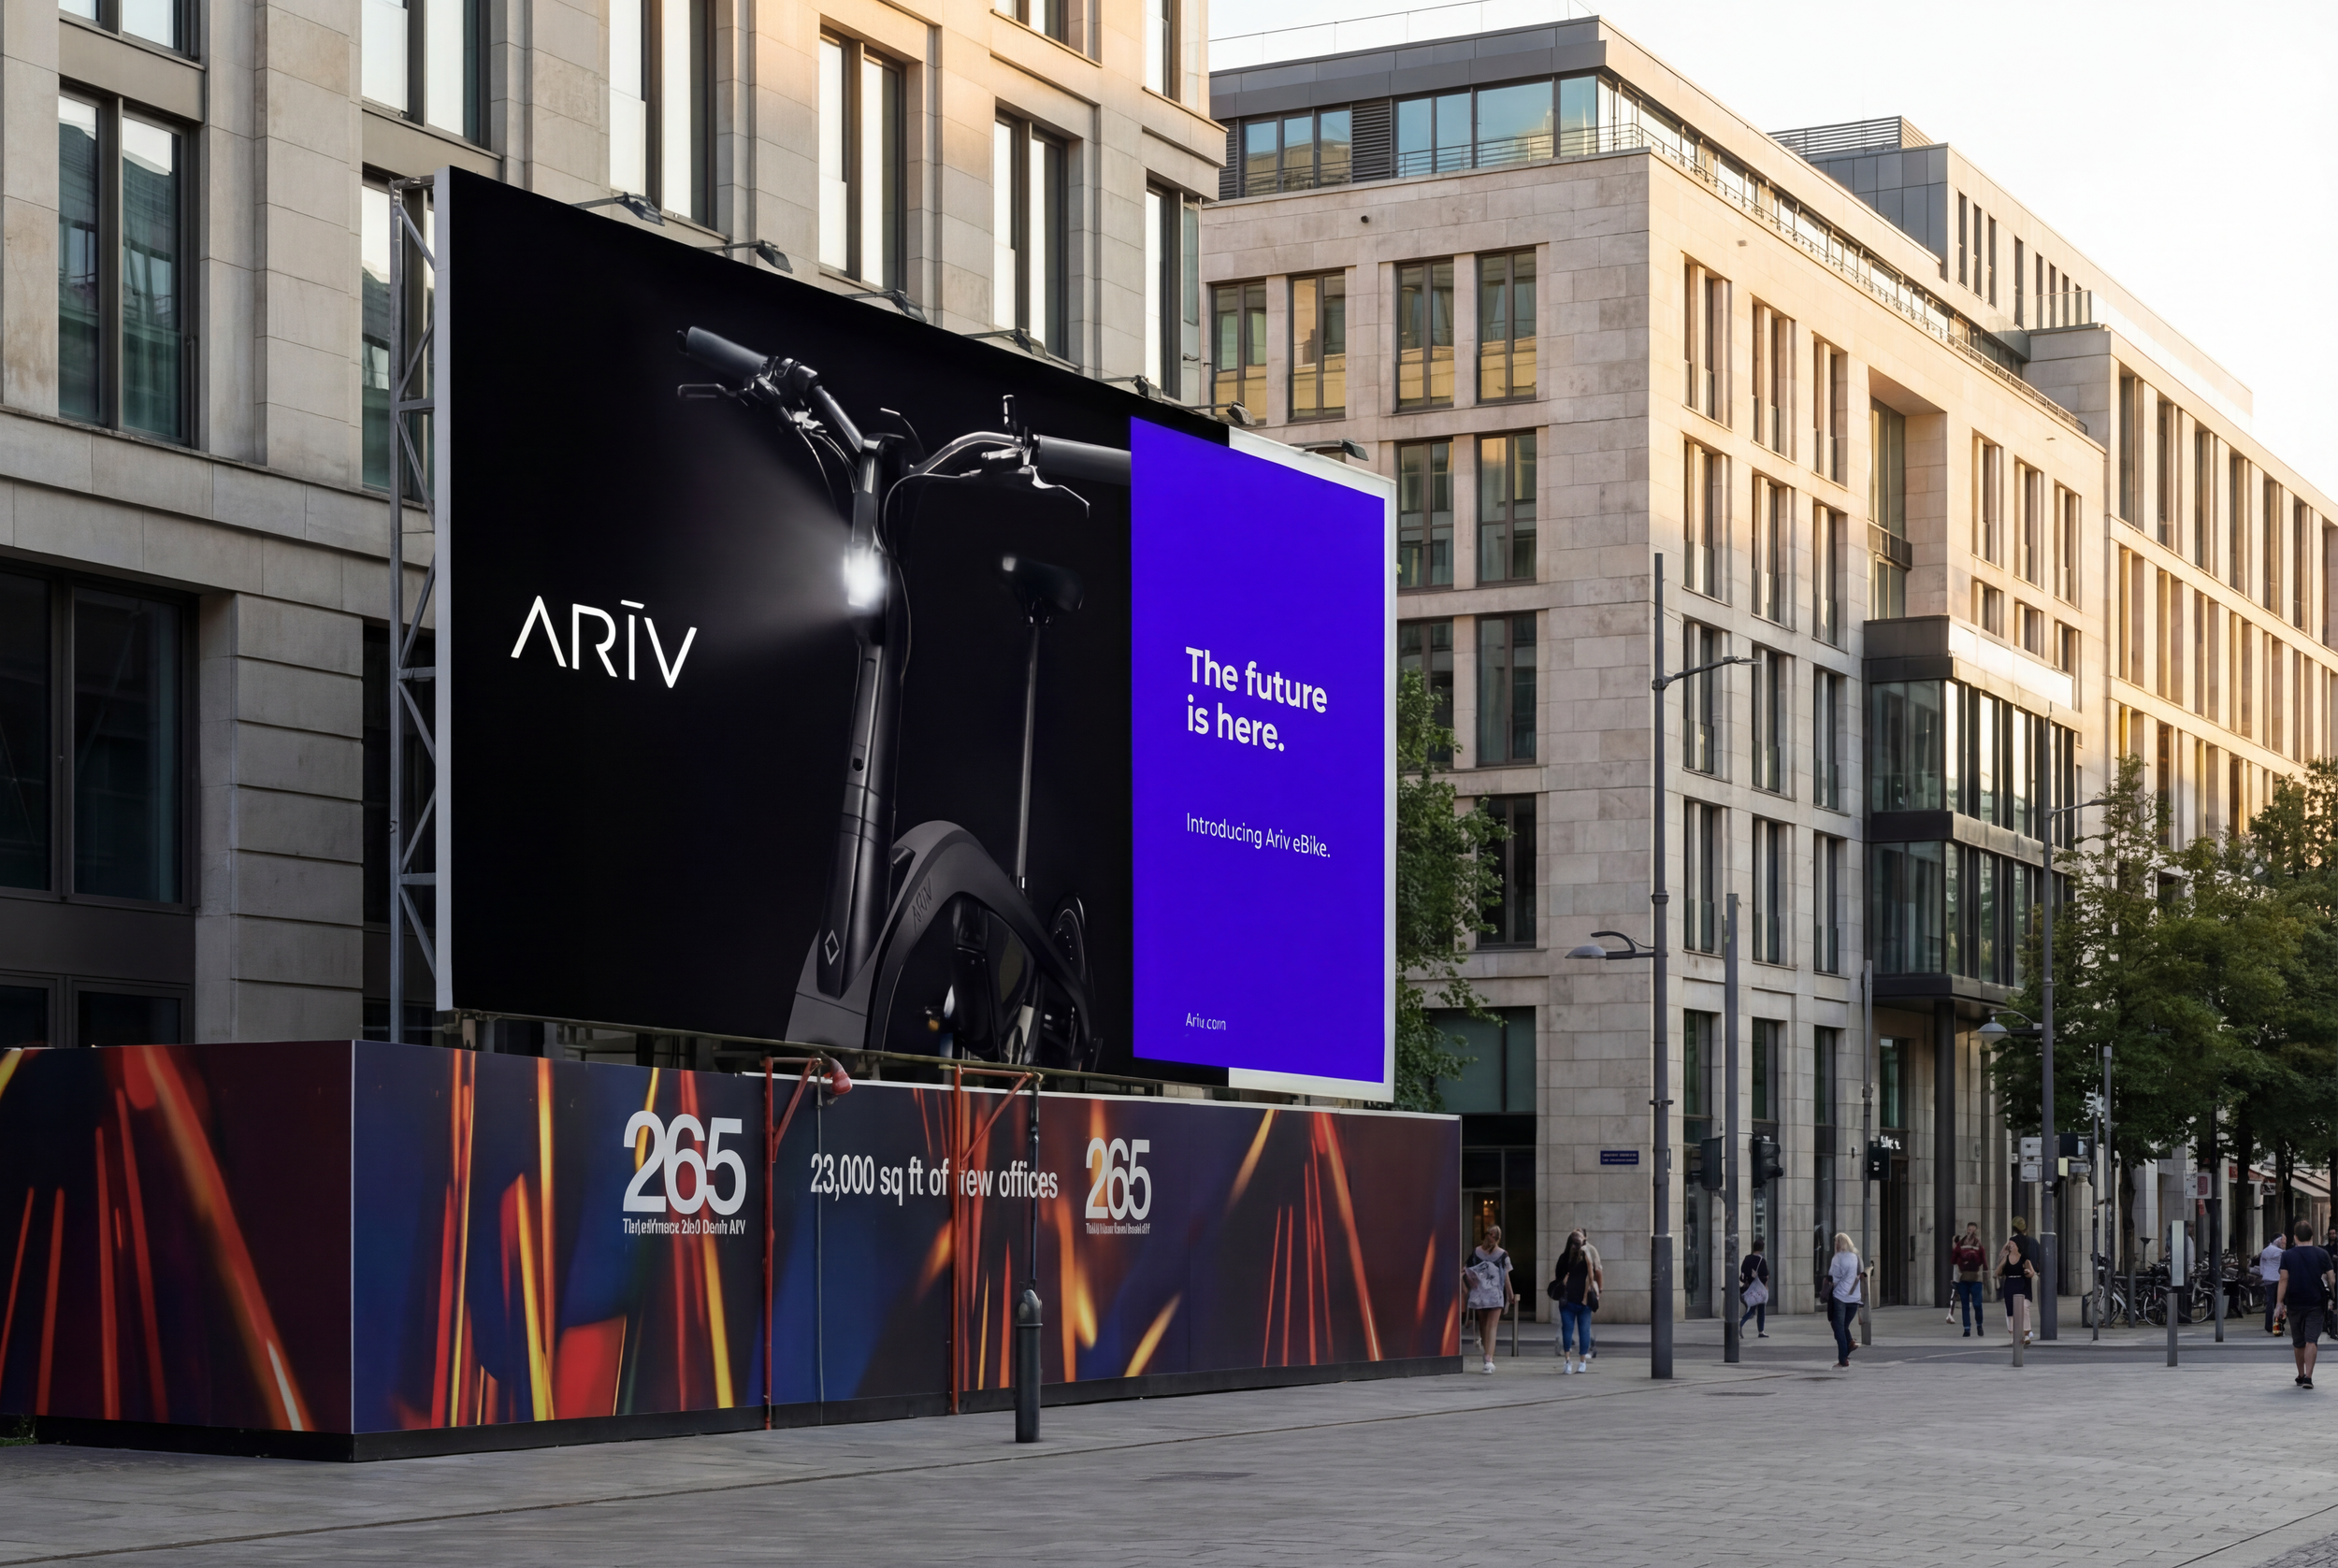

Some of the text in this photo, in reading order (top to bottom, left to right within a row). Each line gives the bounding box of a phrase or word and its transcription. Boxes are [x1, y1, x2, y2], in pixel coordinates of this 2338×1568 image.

[1185, 646, 1327, 713] The future
[1187, 694, 1285, 752] is here.
[1187, 813, 1331, 858] Introducing Ariv eBike.
[623, 1110, 747, 1216] 265
[810, 1153, 875, 1201] 23,000
[879, 1166, 902, 1206] sq
[908, 1156, 924, 1196] ft
[929, 1158, 949, 1196] of
[998, 1159, 1059, 1200] offices
[1085, 1137, 1152, 1220] 265
